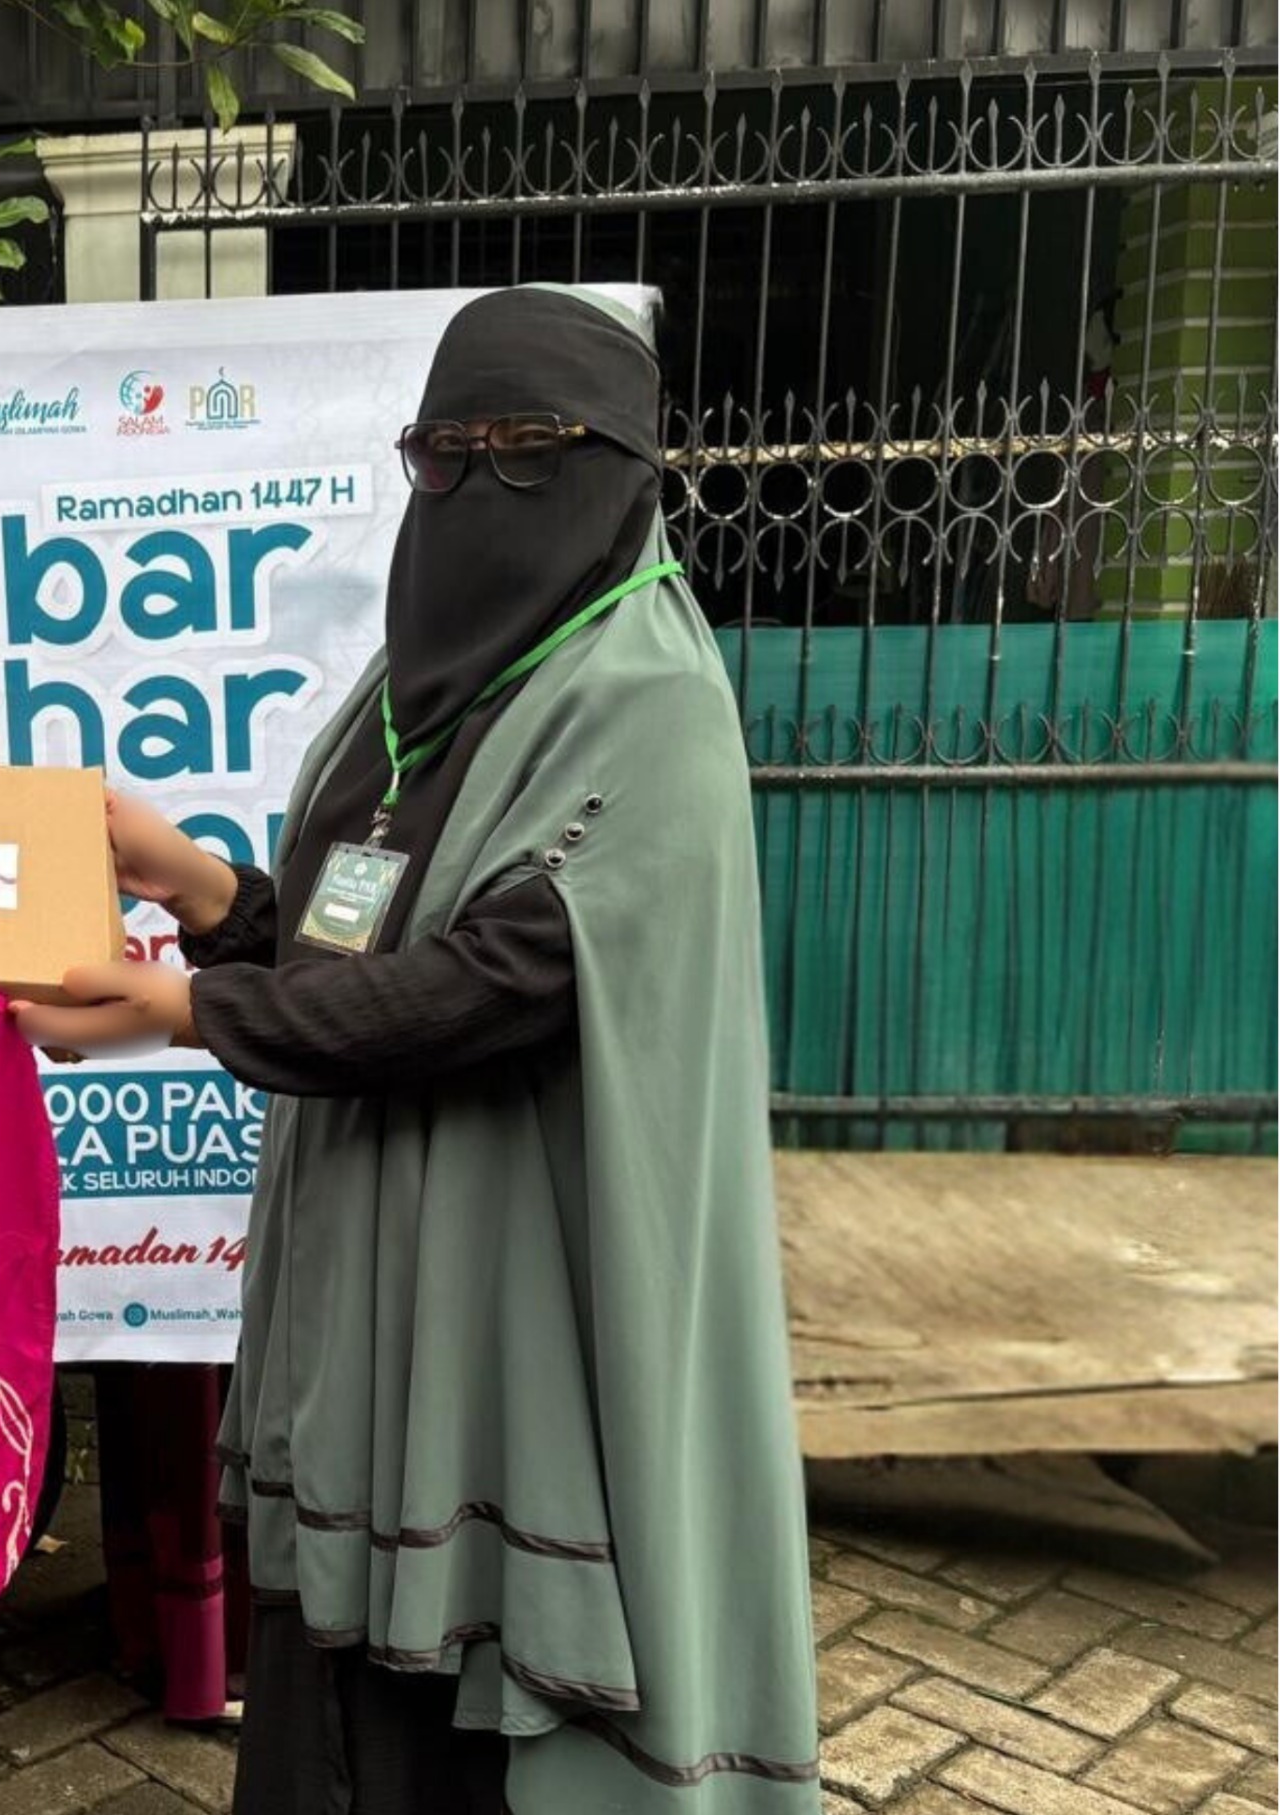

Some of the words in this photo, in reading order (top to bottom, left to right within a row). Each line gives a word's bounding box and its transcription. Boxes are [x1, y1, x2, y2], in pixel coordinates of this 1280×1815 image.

[57, 489, 242, 522] Ramadhan
[250, 478, 322, 509] 1447
[330, 475, 354, 505] H
[83, 1168, 190, 1191] SELURUH
[78, 1311, 114, 1321] Gowa
